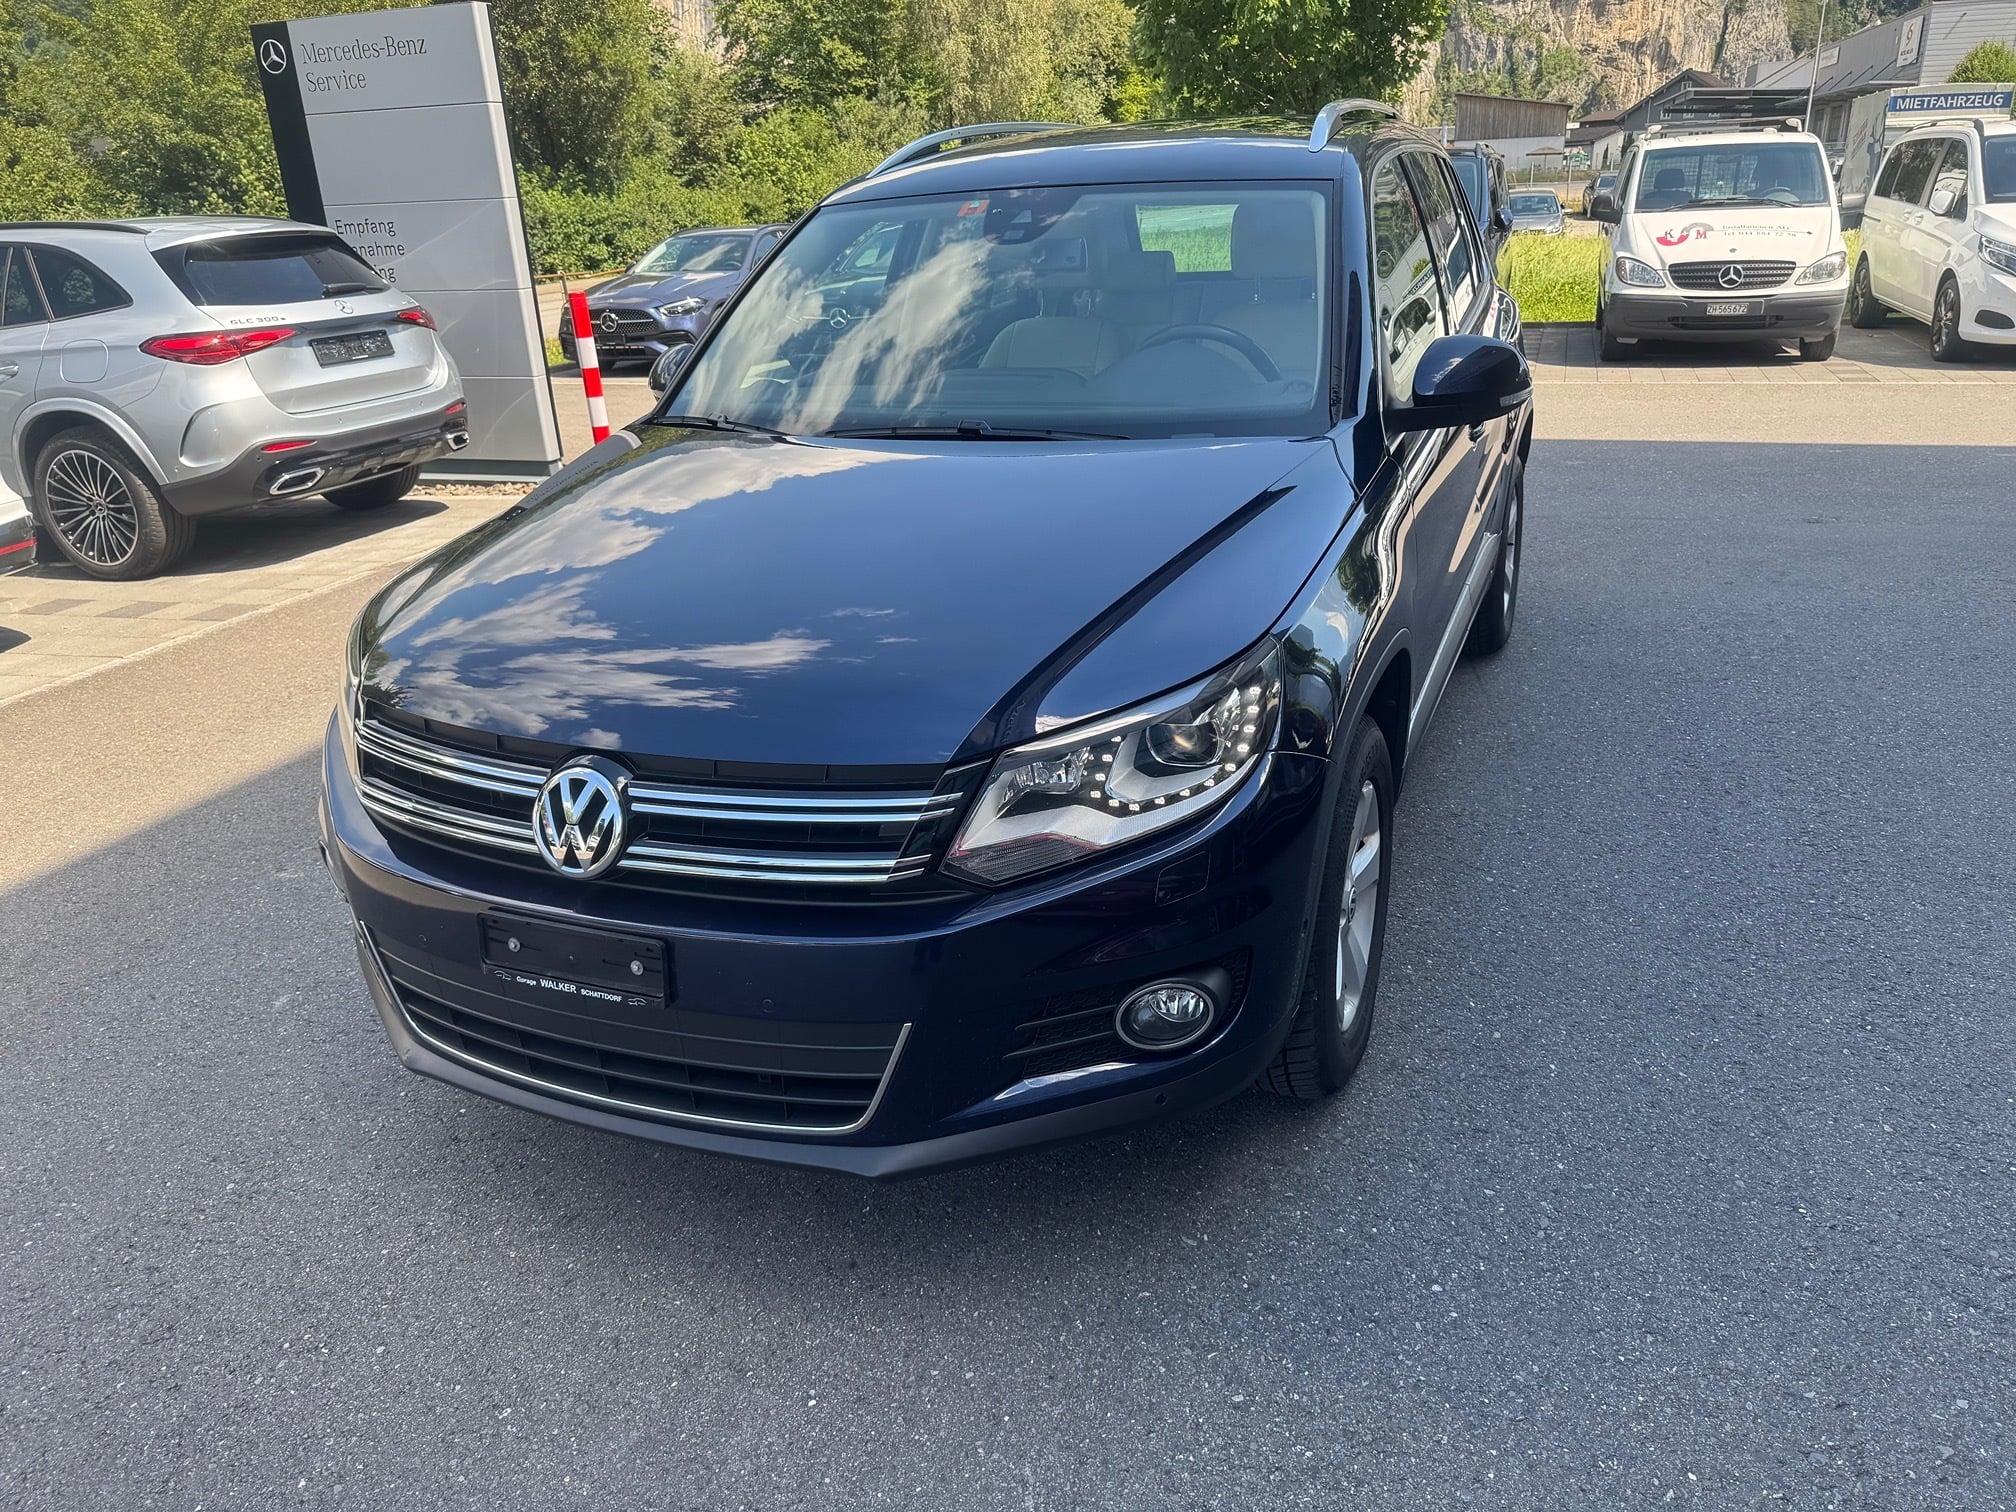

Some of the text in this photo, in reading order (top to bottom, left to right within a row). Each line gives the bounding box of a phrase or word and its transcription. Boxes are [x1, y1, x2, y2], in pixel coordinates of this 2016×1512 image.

[301, 35, 427, 65] Mercedes-Benz
[305, 69, 367, 92] Service
[1896, 94, 2004, 110] MIETFAHRZEUG
[335, 218, 396, 238] Empfang
[516, 975, 623, 1003] Garage WALKER SCHATTDORF
